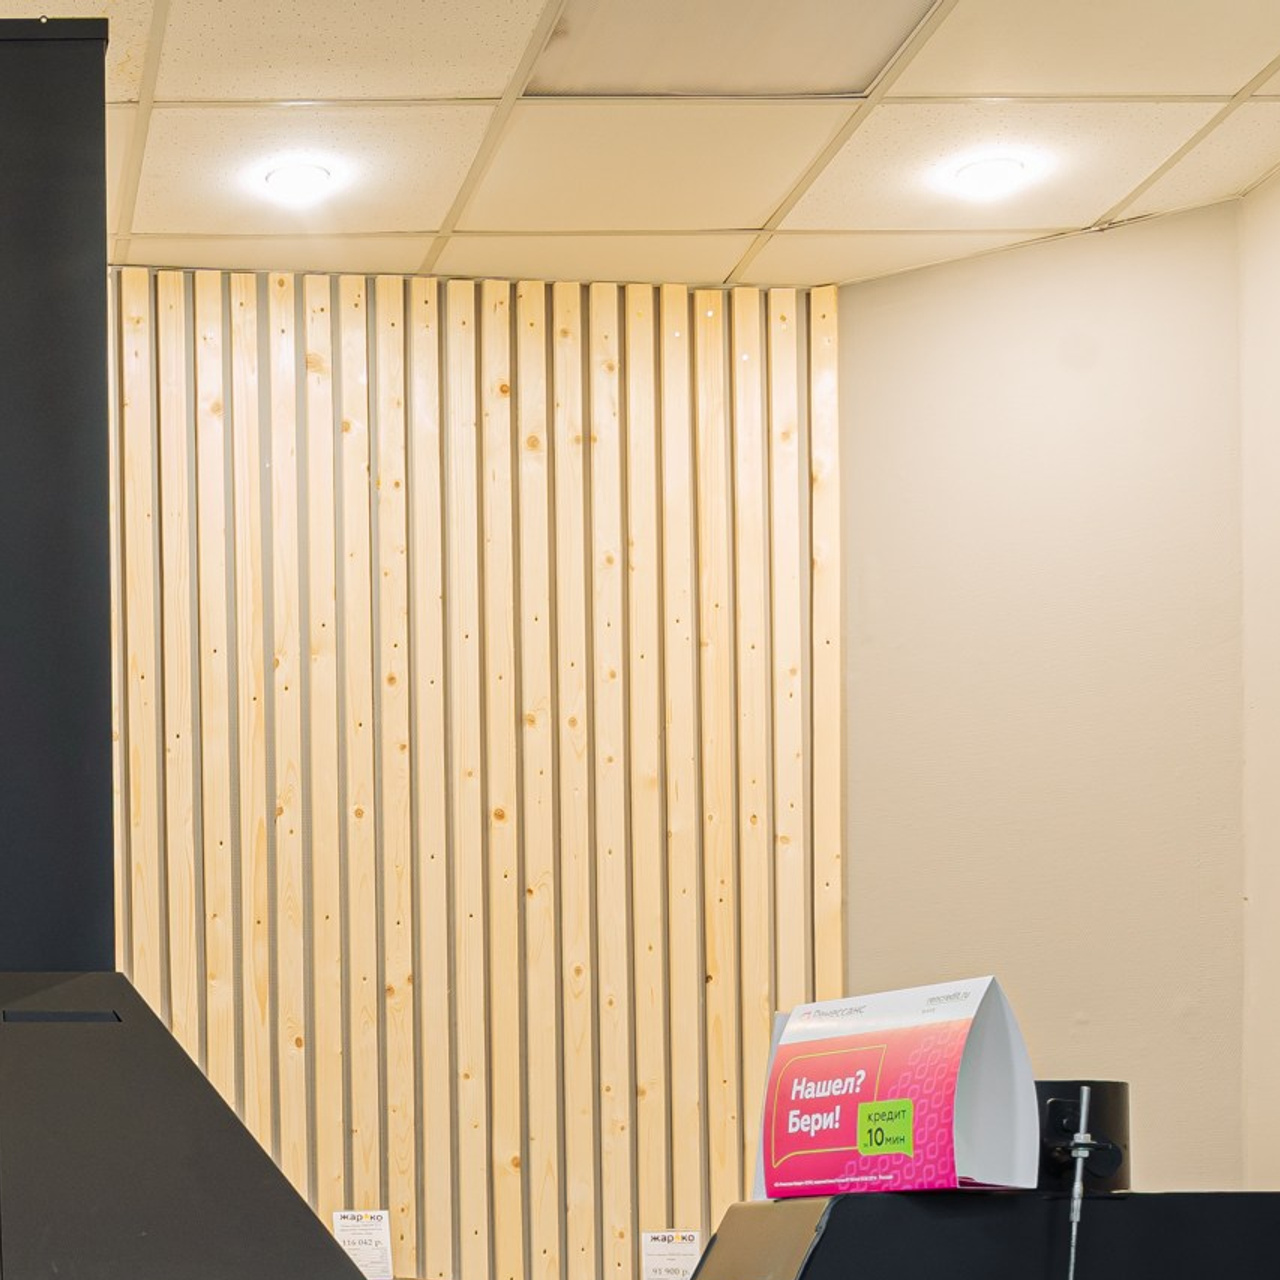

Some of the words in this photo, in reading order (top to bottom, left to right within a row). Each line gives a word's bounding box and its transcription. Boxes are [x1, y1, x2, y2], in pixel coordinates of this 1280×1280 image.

[791, 1069, 866, 1100] Нашел?
[788, 1105, 841, 1137] Бери!
[867, 1109, 907, 1123] кредит
